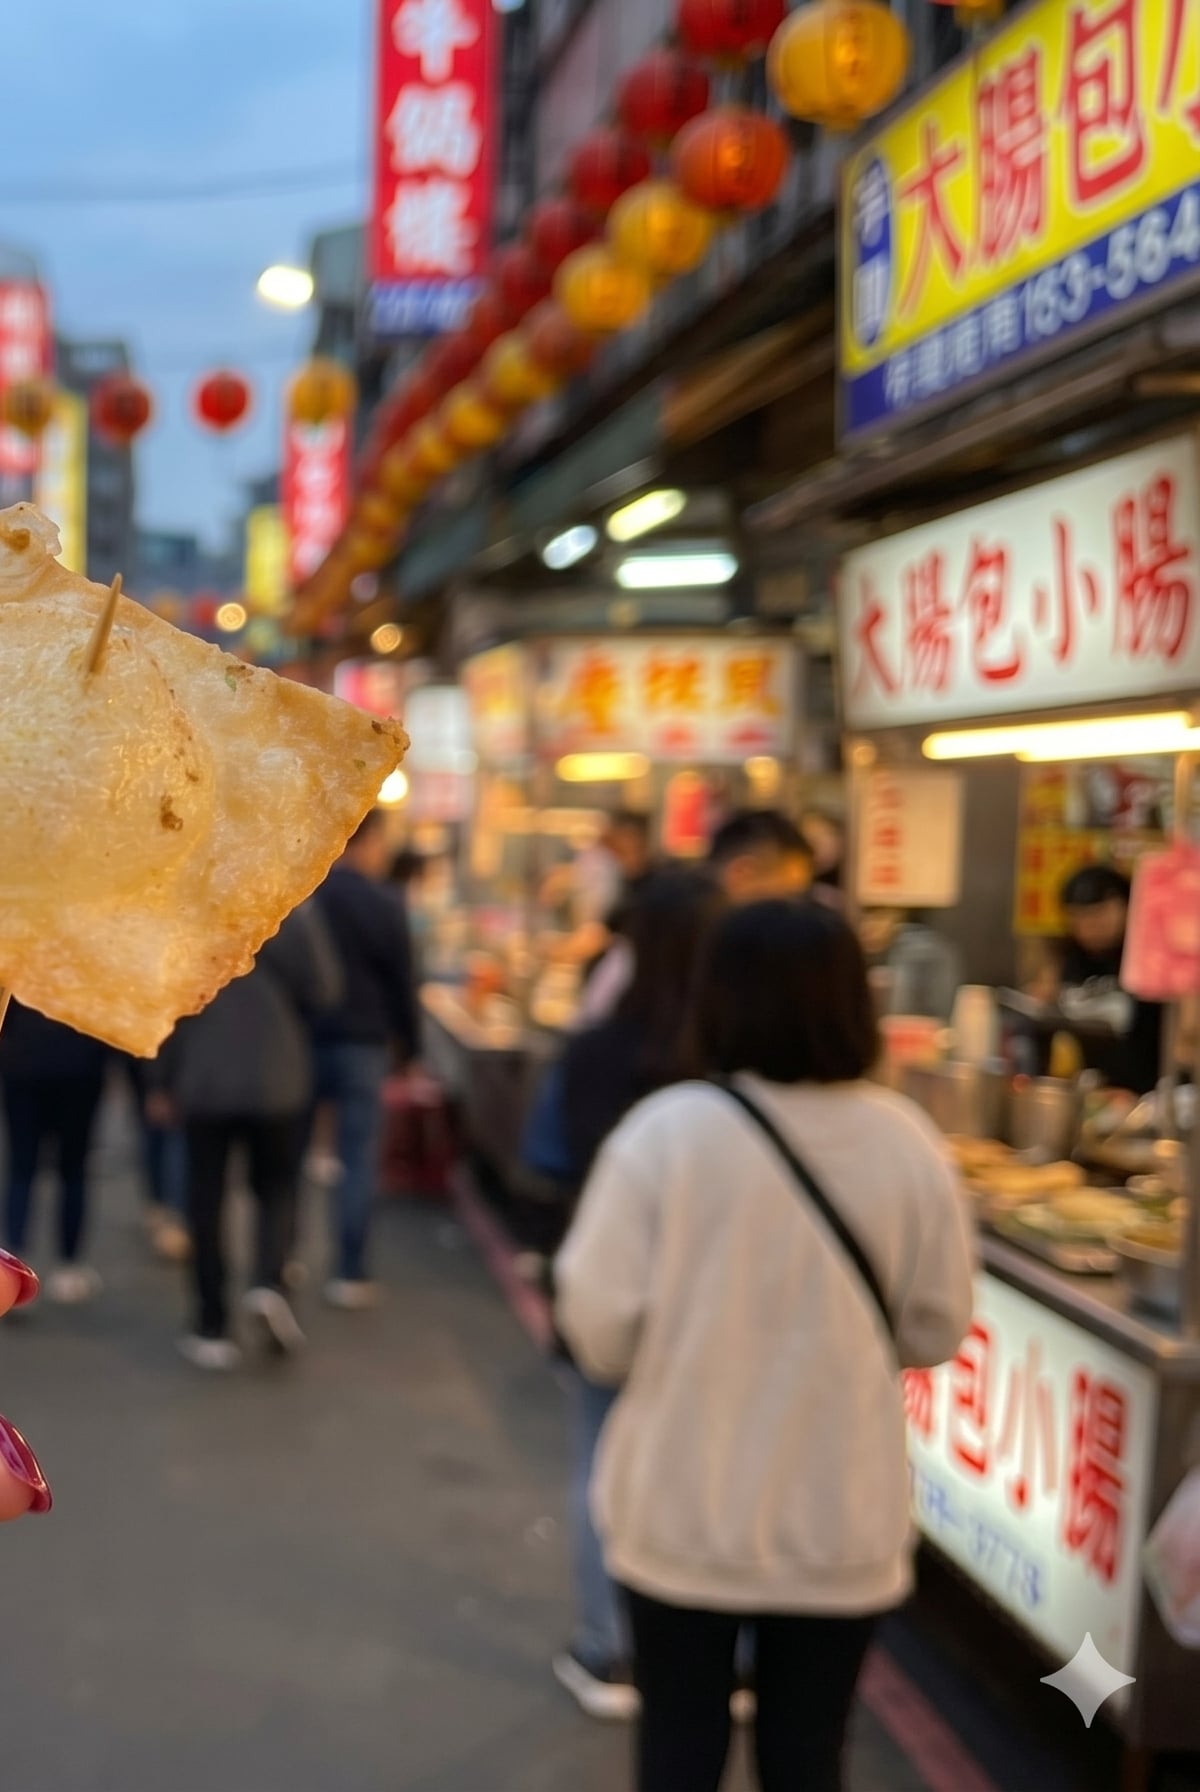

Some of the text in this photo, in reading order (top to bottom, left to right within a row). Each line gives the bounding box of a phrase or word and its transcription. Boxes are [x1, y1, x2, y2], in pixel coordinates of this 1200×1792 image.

[851, 473, 1191, 697] 大腸包小腸
